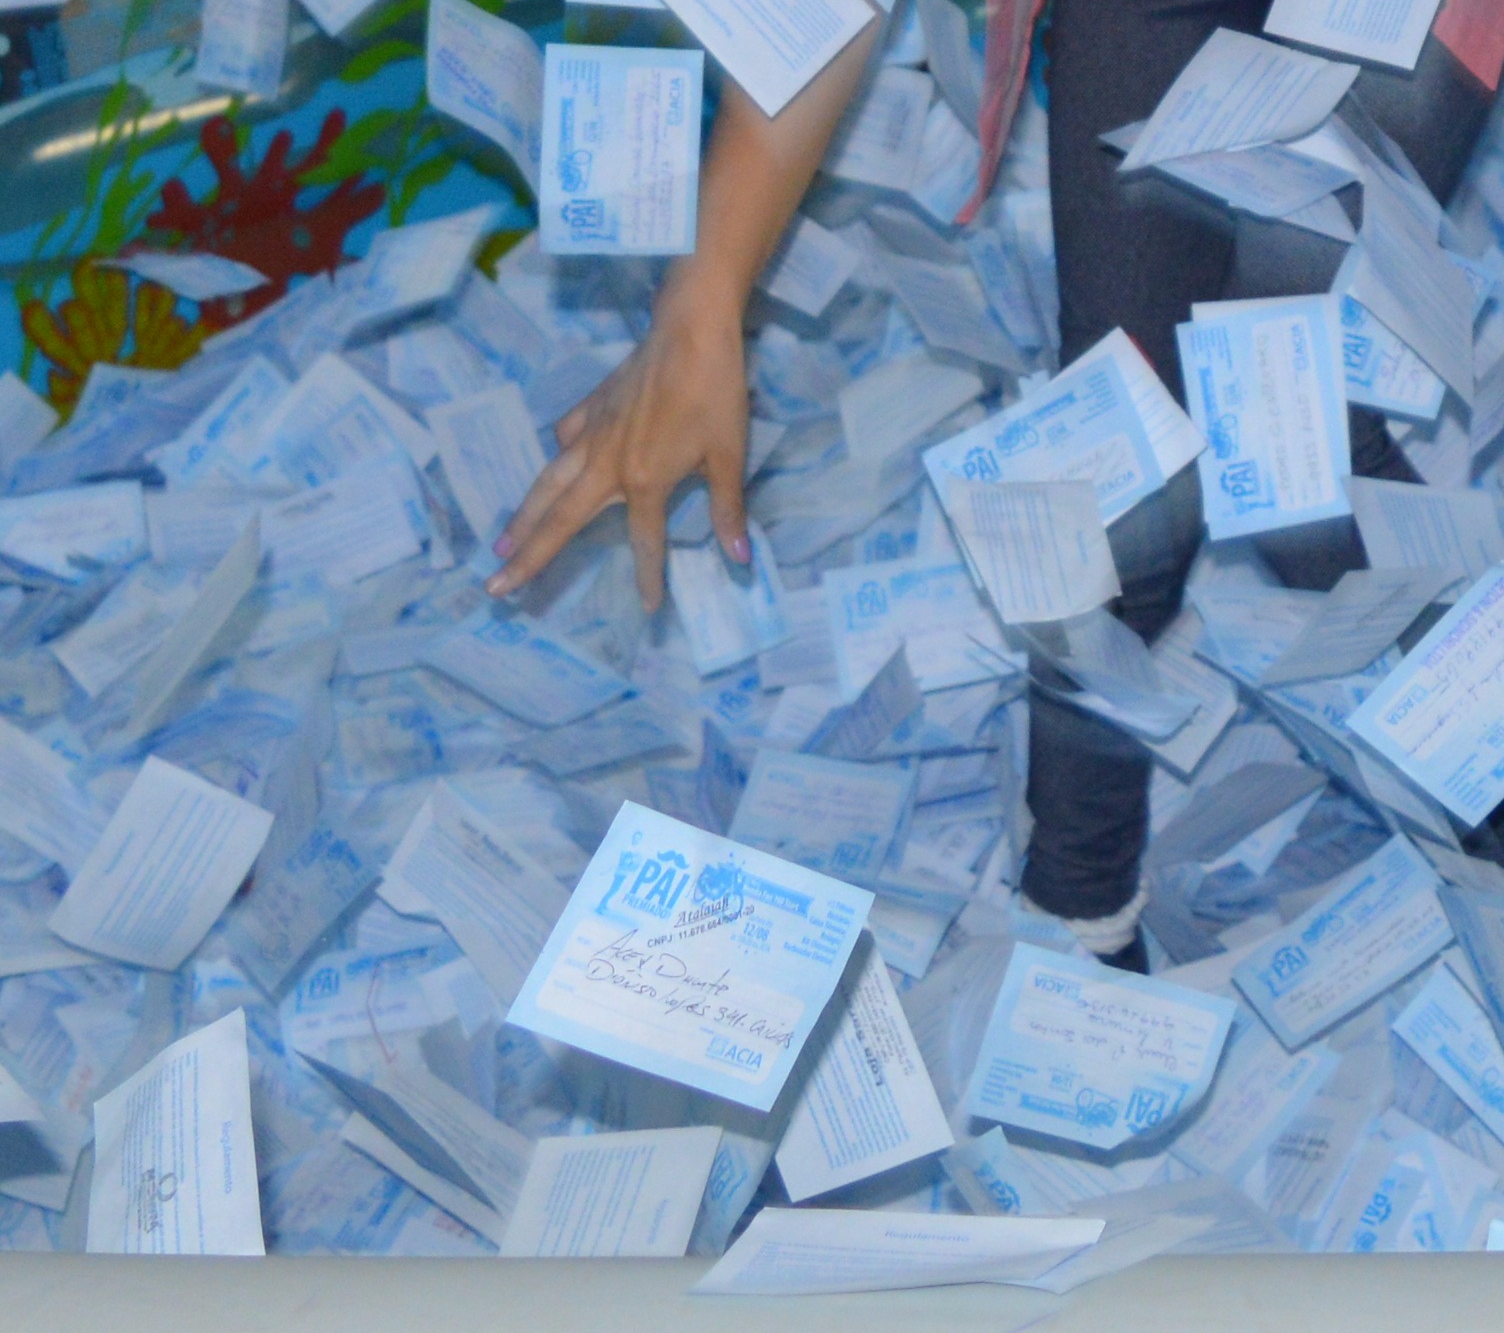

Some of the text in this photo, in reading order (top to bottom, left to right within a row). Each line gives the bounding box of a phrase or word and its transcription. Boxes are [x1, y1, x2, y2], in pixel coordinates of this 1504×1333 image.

[571, 199, 596, 227] PAI
[1291, 324, 1305, 356] ACIA
[1336, 330, 1372, 371] PAI
[961, 449, 1001, 486] PAI
[1226, 461, 1254, 497] PAI
[1384, 695, 1416, 728] ACIA
[629, 857, 690, 911] PAI
[621, 893, 670, 920] PREMIADO
[646, 933, 675, 948] CNPJ:
[742, 922, 769, 941] 12/08
[1269, 943, 1310, 979] PAI
[306, 972, 342, 999] PAI
[1033, 975, 1064, 993] ACIA
[724, 1041, 764, 1070] ACIA
[1123, 1090, 1166, 1128] PAI
[220, 1120, 233, 1194] Regulamento
[884, 1231, 969, 1242] Regulamento
